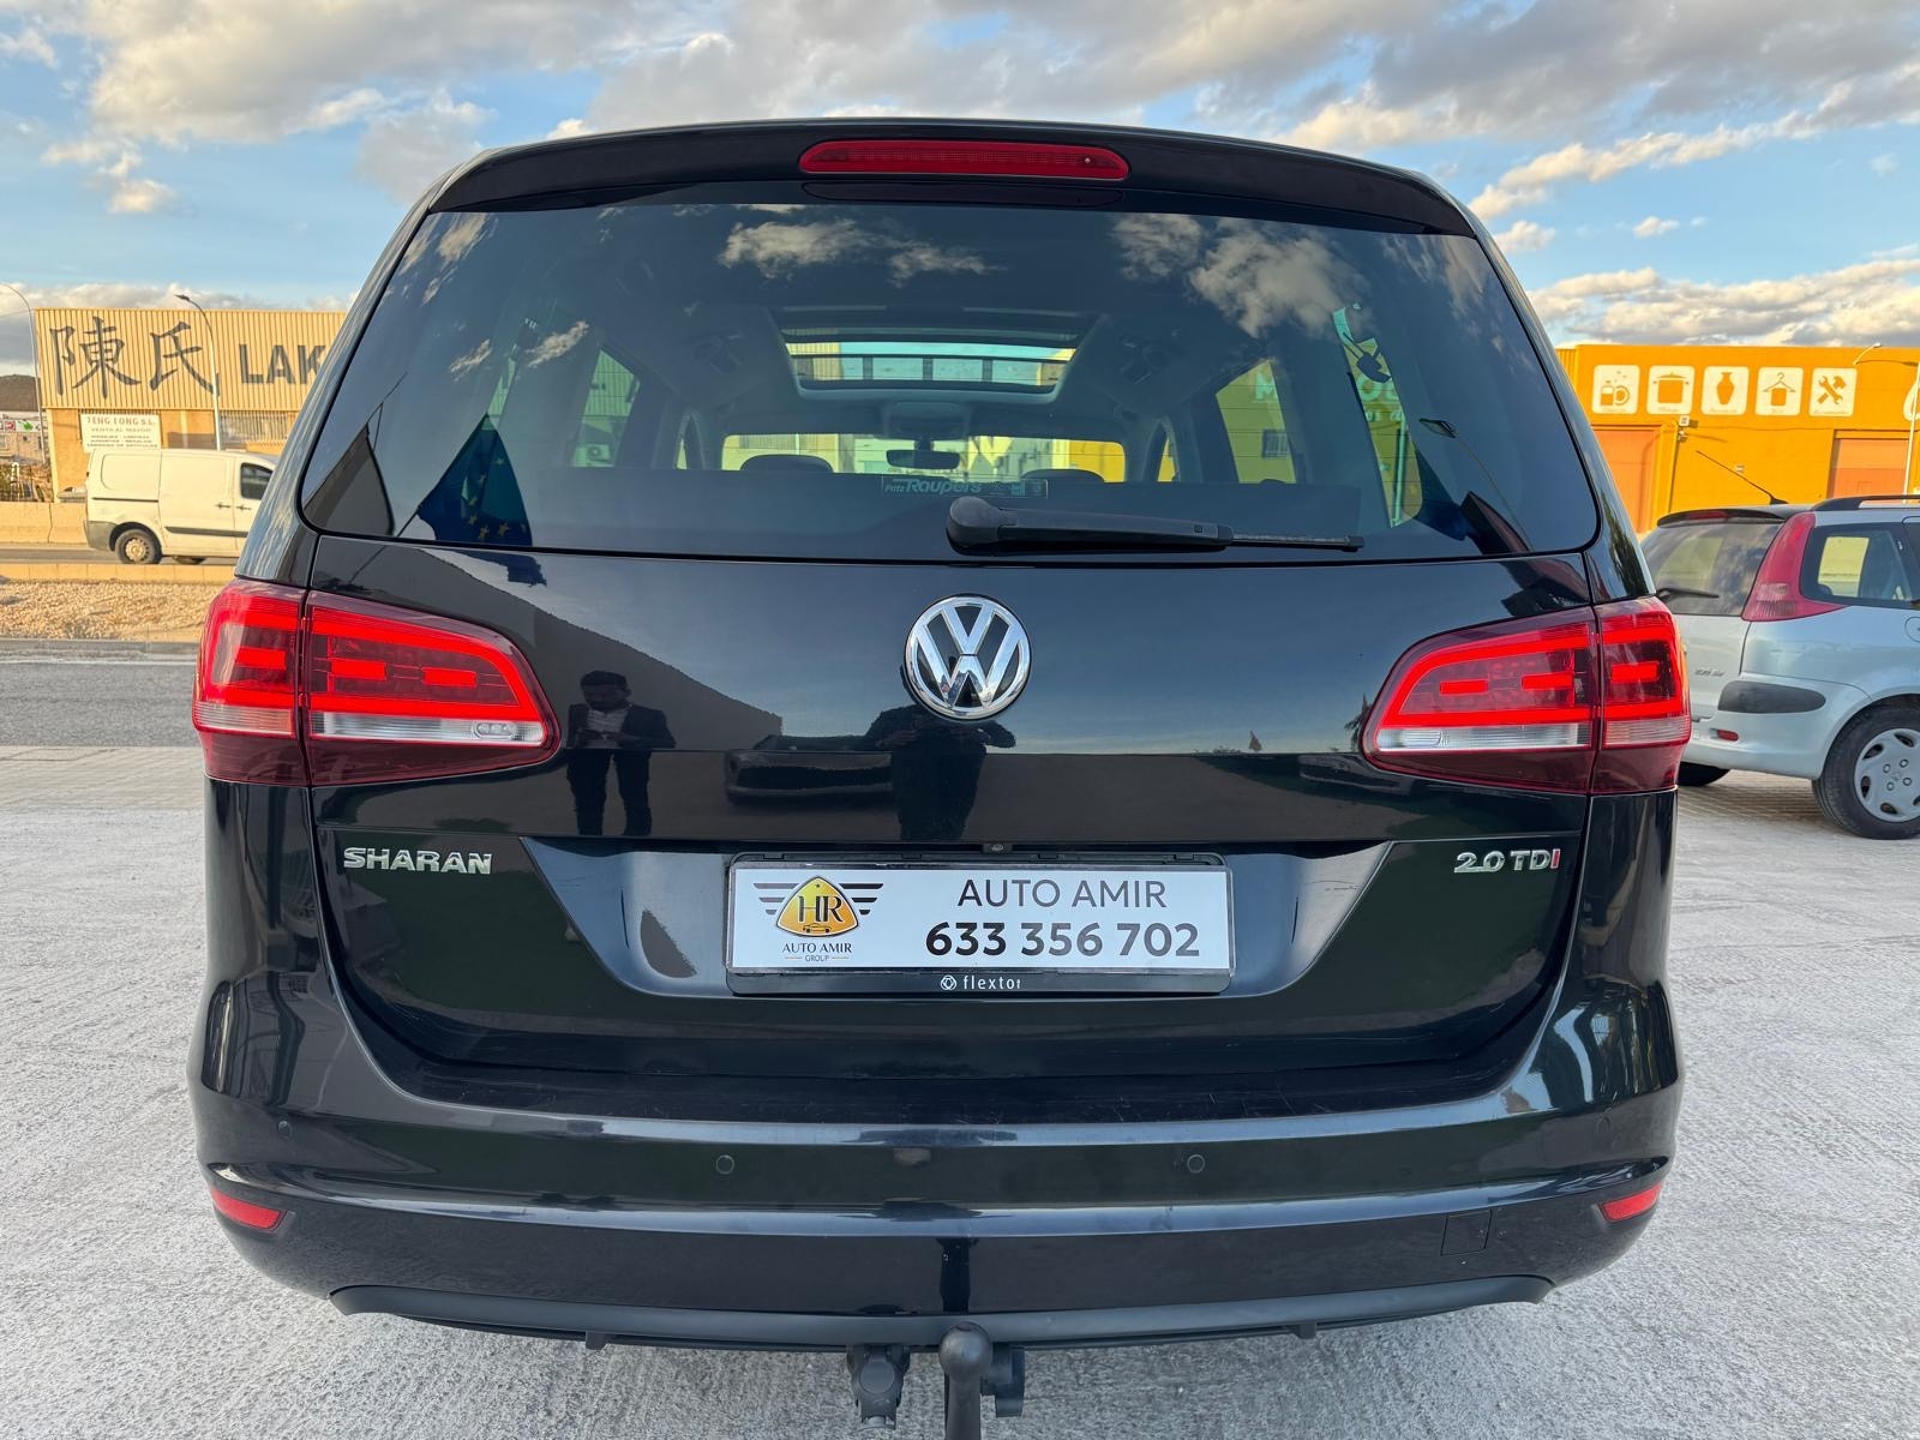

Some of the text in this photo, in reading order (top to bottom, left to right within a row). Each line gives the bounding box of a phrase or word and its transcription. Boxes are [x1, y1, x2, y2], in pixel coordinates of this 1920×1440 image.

[343, 846, 492, 875] SHARAN
[1510, 848, 1561, 871] TDI
[957, 879, 1167, 908] AUTO AMIR
[797, 895, 844, 923] HR
[782, 942, 852, 954] AUTO AMIR
[926, 922, 1200, 957] 633 356 702
[804, 954, 830, 962] GROUP
